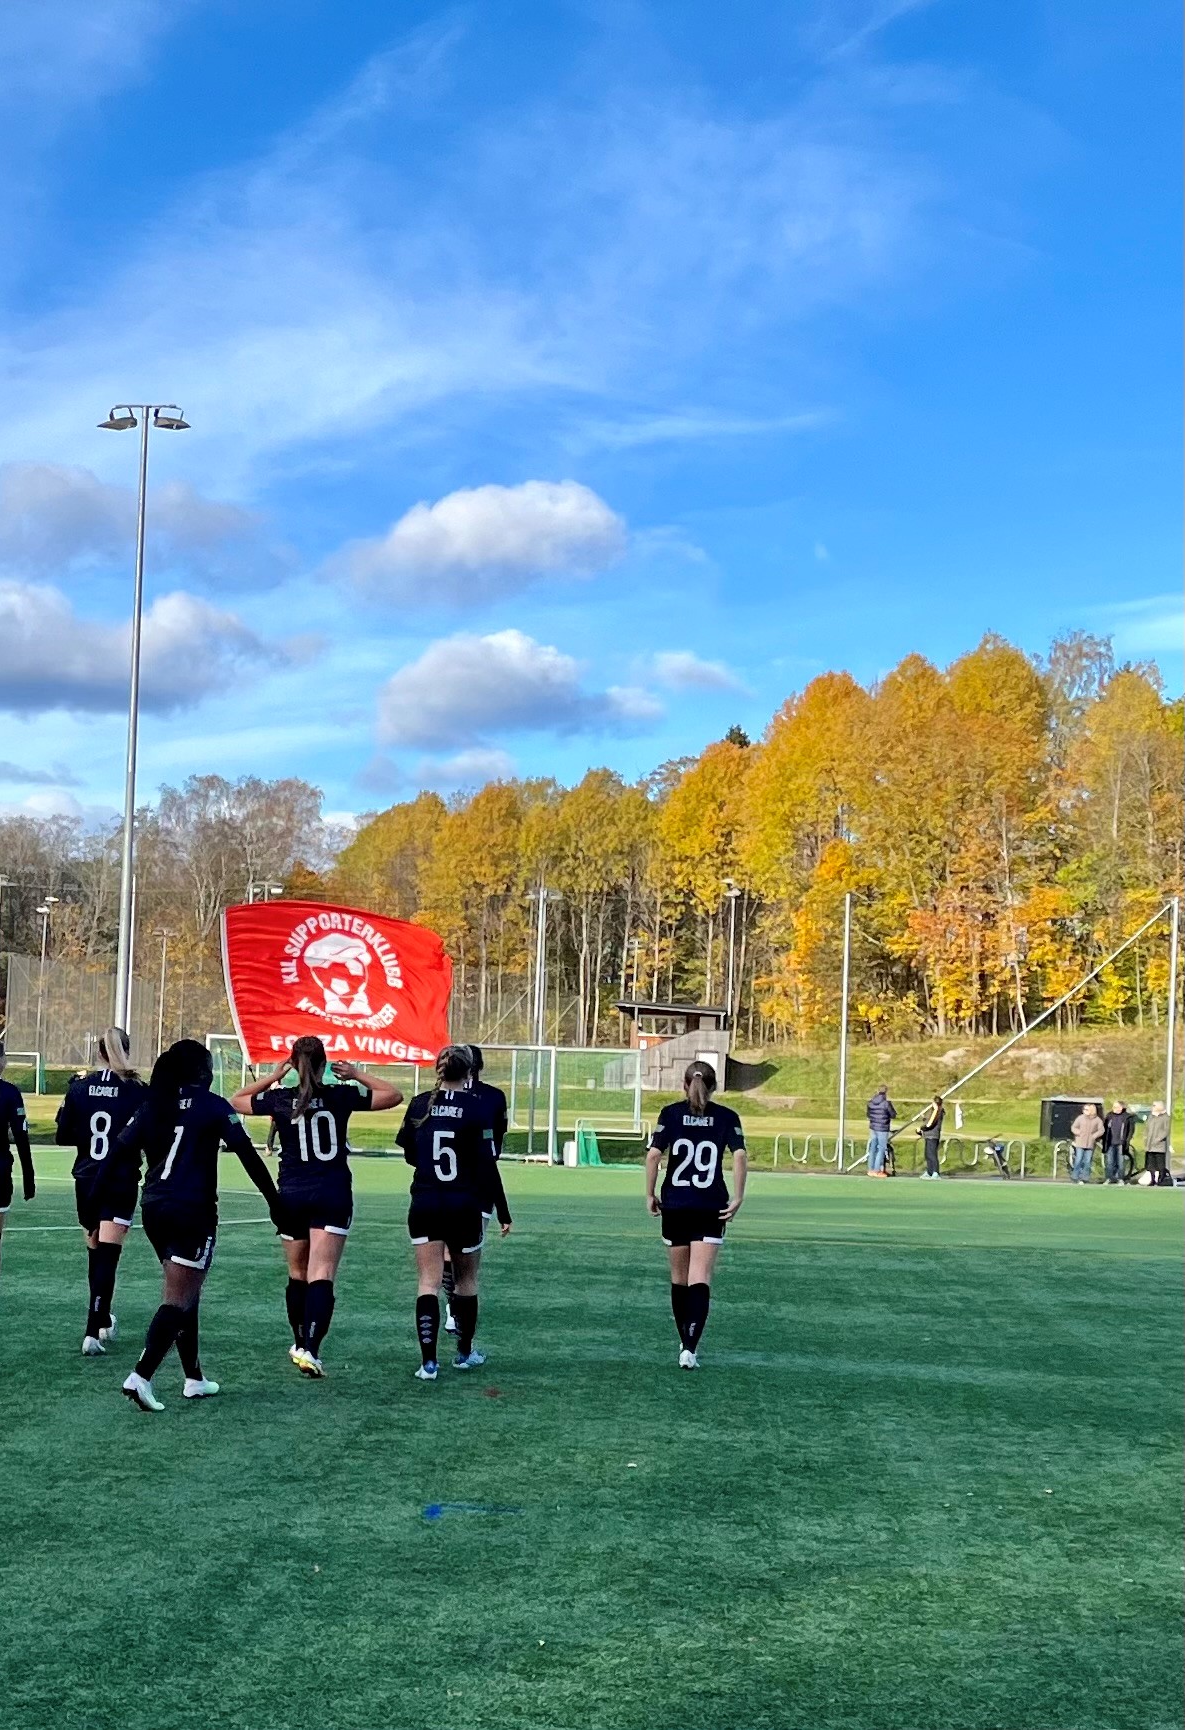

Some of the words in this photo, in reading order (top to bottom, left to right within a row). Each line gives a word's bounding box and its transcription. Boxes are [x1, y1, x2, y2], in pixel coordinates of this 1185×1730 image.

[283, 912, 404, 990] SUPPORTERKLUBB
[89, 1110, 112, 1161] 8
[290, 1110, 338, 1162] 10
[432, 1130, 458, 1182] 5
[671, 1137, 718, 1189] 29
